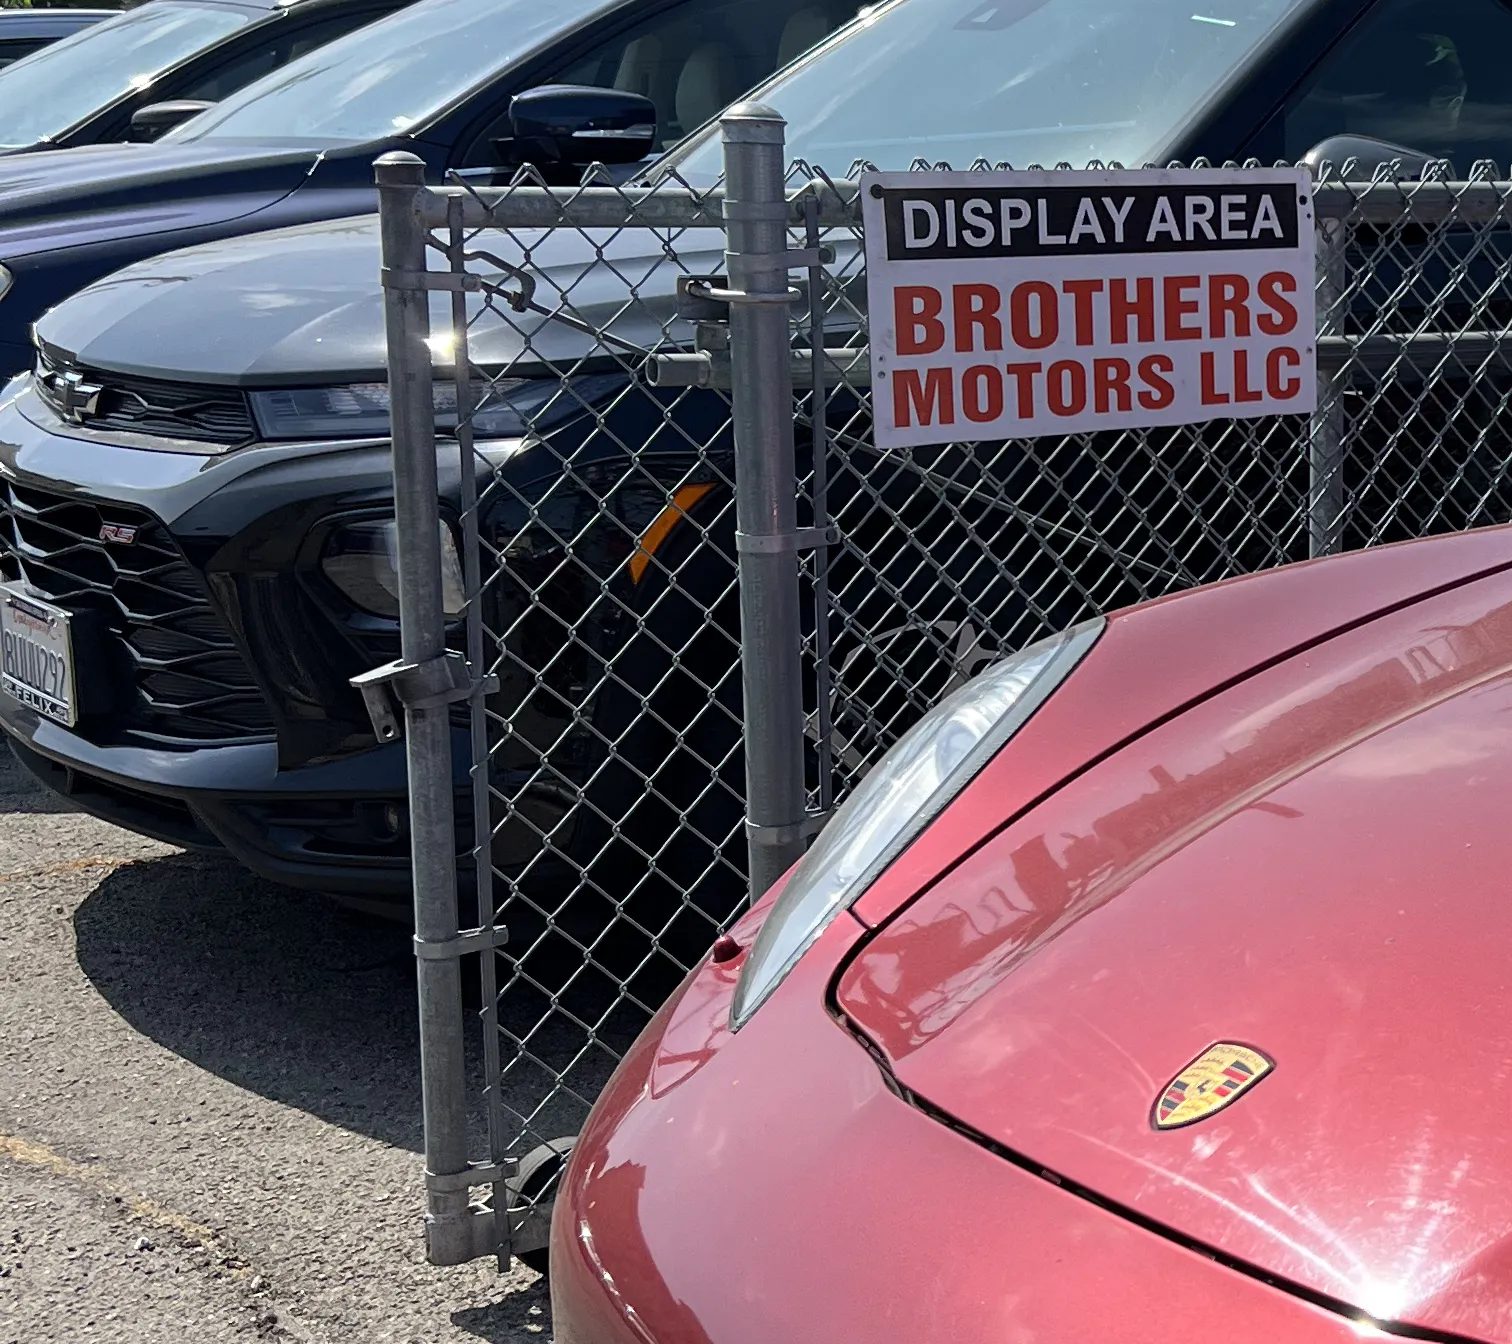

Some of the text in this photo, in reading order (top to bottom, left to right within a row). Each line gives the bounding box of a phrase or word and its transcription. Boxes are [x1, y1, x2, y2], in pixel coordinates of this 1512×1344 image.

[902, 193, 1284, 250] DISPLAY AREA
[893, 271, 1299, 356] BROTHERS
[892, 346, 1300, 428] MOTORS LLC
[99, 524, 136, 544] RS
[15, 685, 54, 716] FELIX
